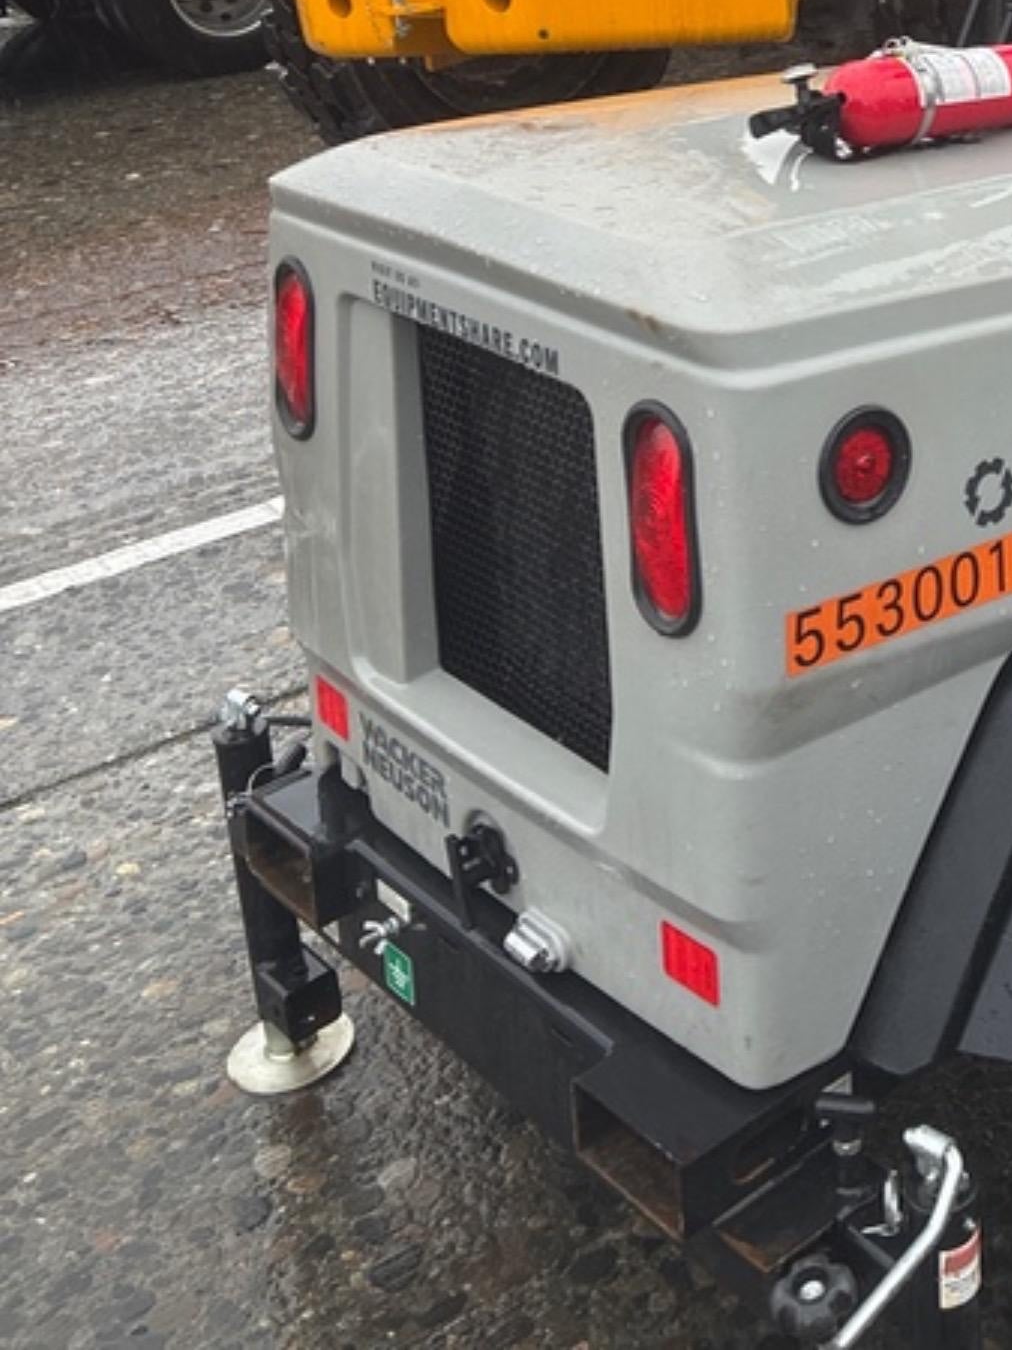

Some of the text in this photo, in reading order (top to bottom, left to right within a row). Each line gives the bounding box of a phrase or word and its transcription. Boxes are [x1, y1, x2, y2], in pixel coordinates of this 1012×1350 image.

[371, 278, 559, 376] EQUIPMENTSHARE.COM
[793, 539, 1007, 668] 553001
[359, 711, 447, 799] WACKER
[362, 740, 451, 829] NEUSON
